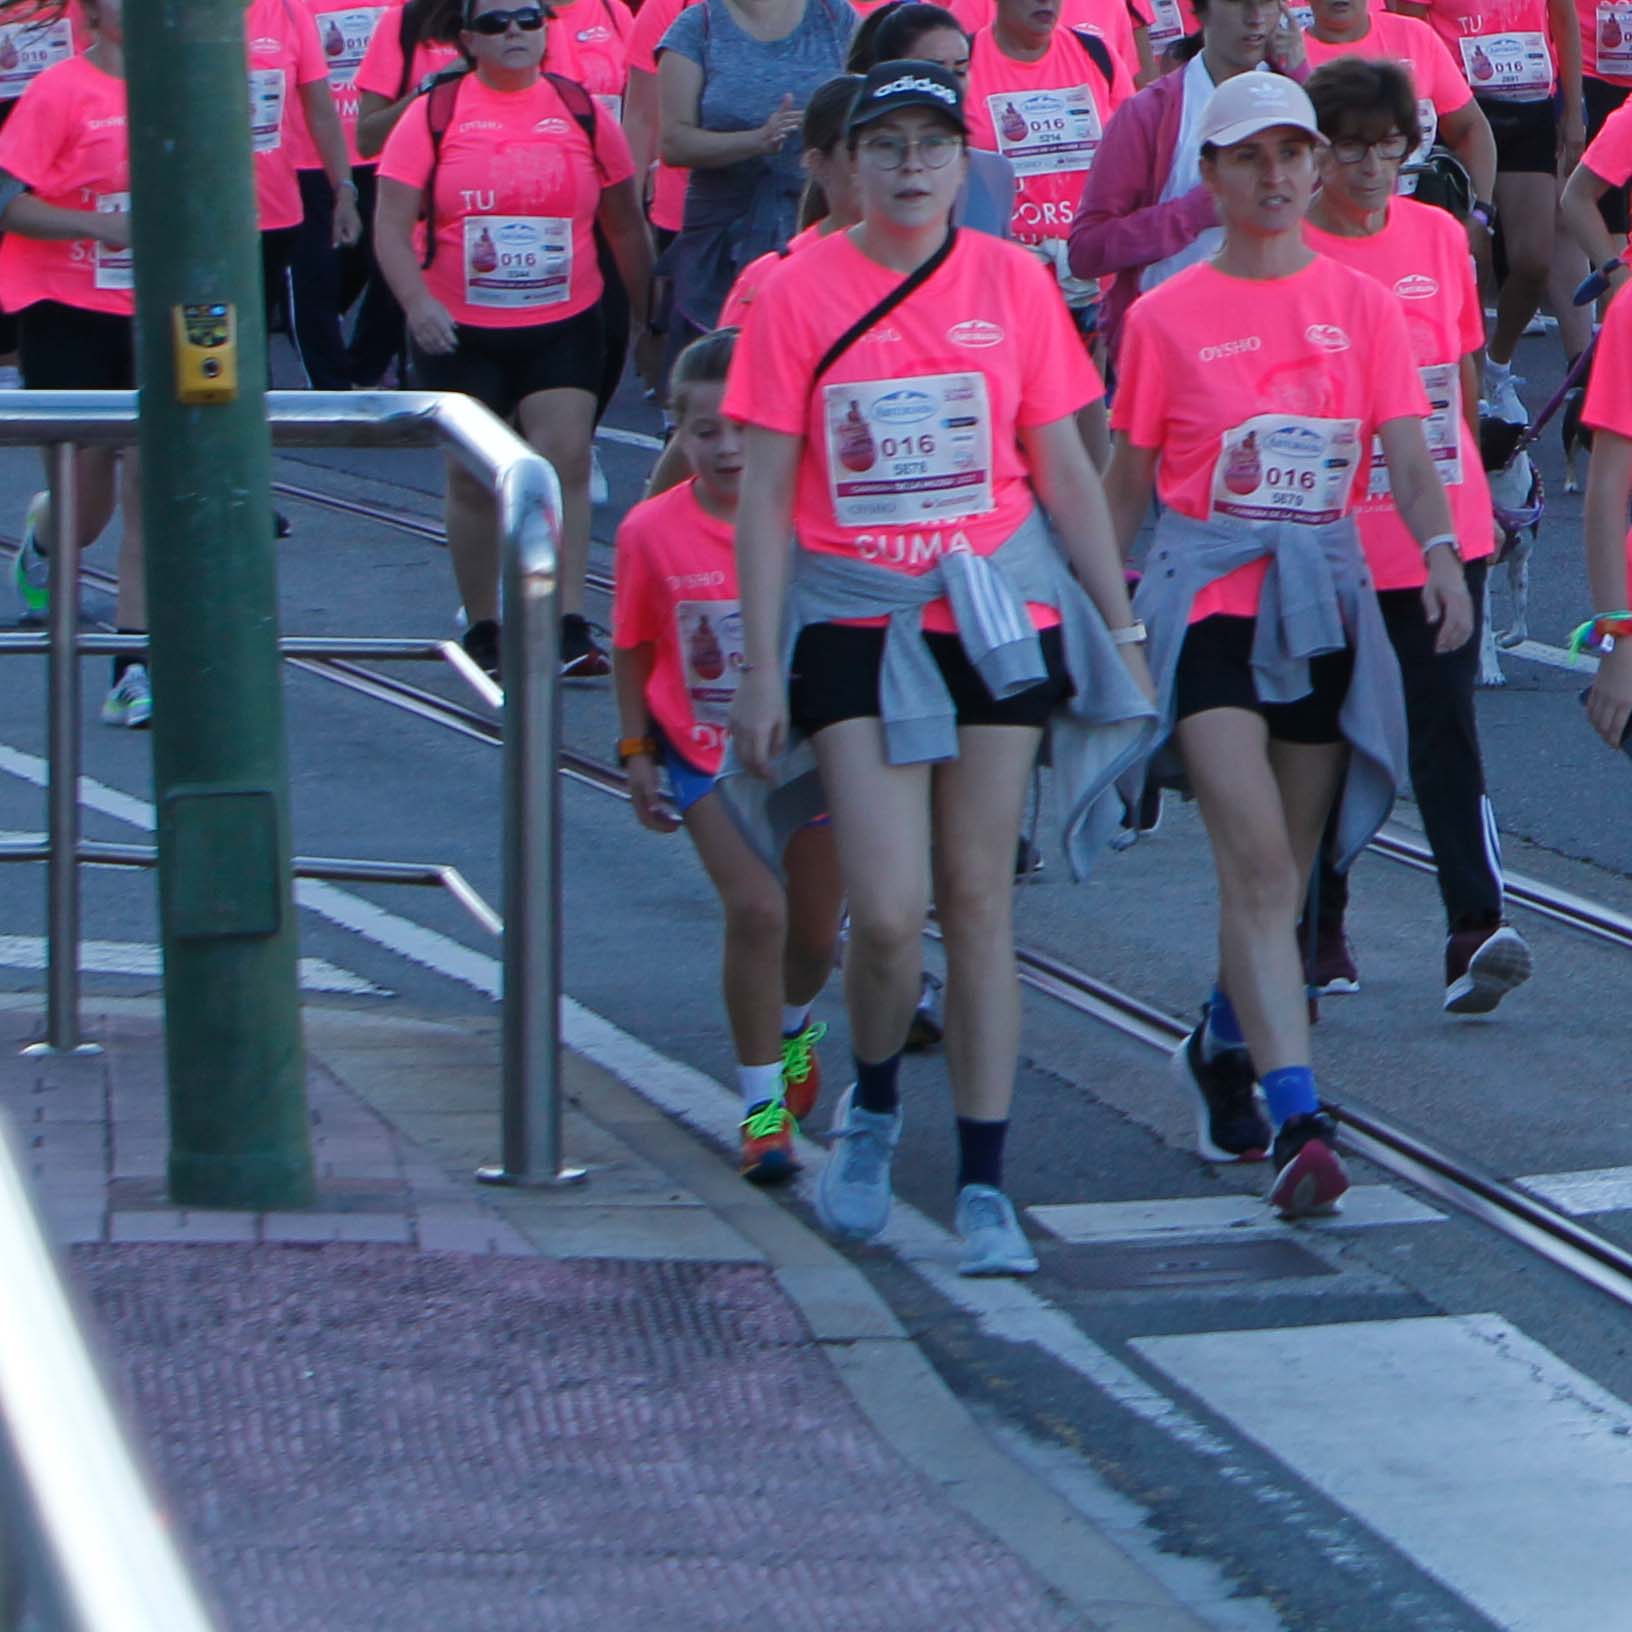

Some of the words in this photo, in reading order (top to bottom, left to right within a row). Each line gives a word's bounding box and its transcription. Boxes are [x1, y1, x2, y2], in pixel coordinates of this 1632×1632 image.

[1457, 15, 1484, 34] TU
[1494, 60, 1524, 73] 016
[873, 75, 957, 105] adidas
[1030, 118, 1065, 132] 016
[460, 190, 496, 210] TU
[501, 253, 537, 267] 016
[1200, 336, 1262, 362] OYSHO
[881, 434, 936, 457] 016
[1266, 467, 1317, 489] 016
